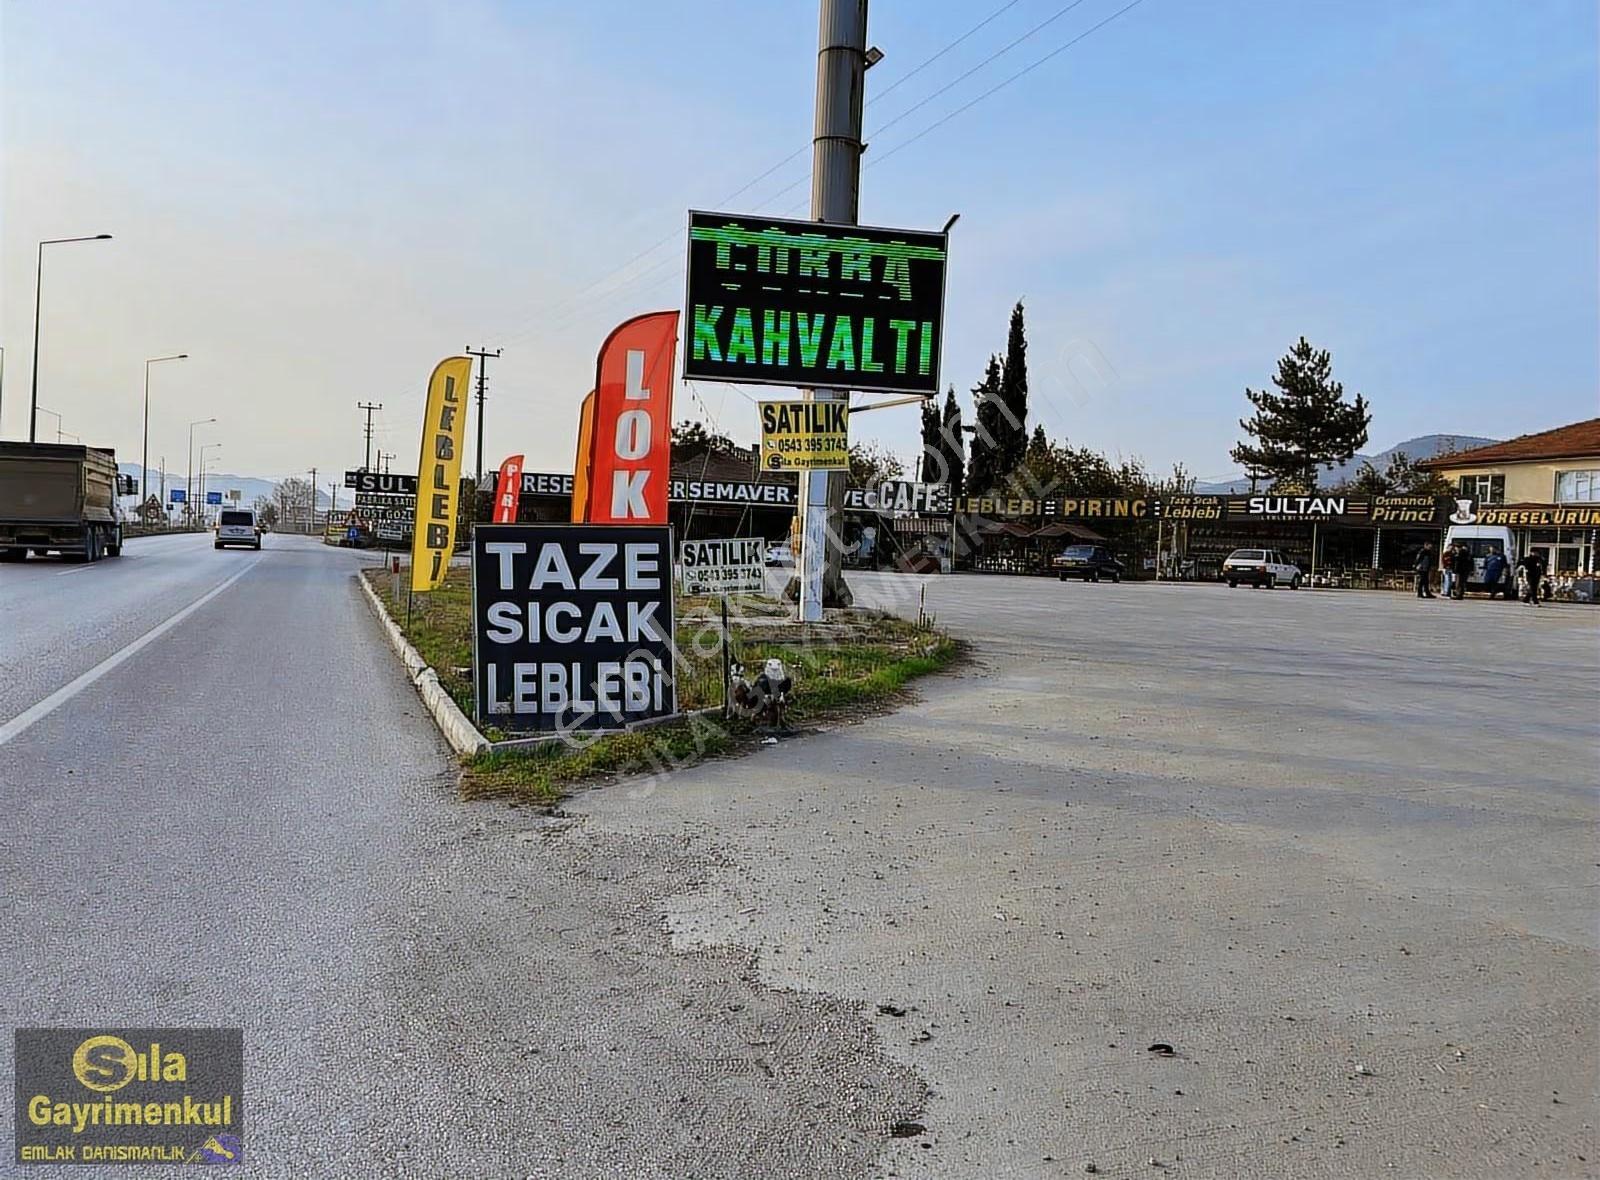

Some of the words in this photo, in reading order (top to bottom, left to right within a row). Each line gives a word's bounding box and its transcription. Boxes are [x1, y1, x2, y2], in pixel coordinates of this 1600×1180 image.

[693, 303, 934, 376] KAHVALTI
[762, 403, 848, 434] SATILIK
[610, 349, 652, 519] LOK
[778, 438, 802, 453] 0543
[804, 438, 822, 452] 395
[824, 437, 848, 452] 3743
[689, 481, 790, 503] SEMAVER
[1164, 505, 1222, 520] Leblebi
[1248, 496, 1346, 515] SULTAN
[1371, 506, 1436, 522] Pirinci
[1475, 508, 1550, 525] YÖRESEL
[485, 541, 661, 590] TAZE
[683, 541, 761, 567] SATILIK
[485, 601, 663, 644] SICAK
